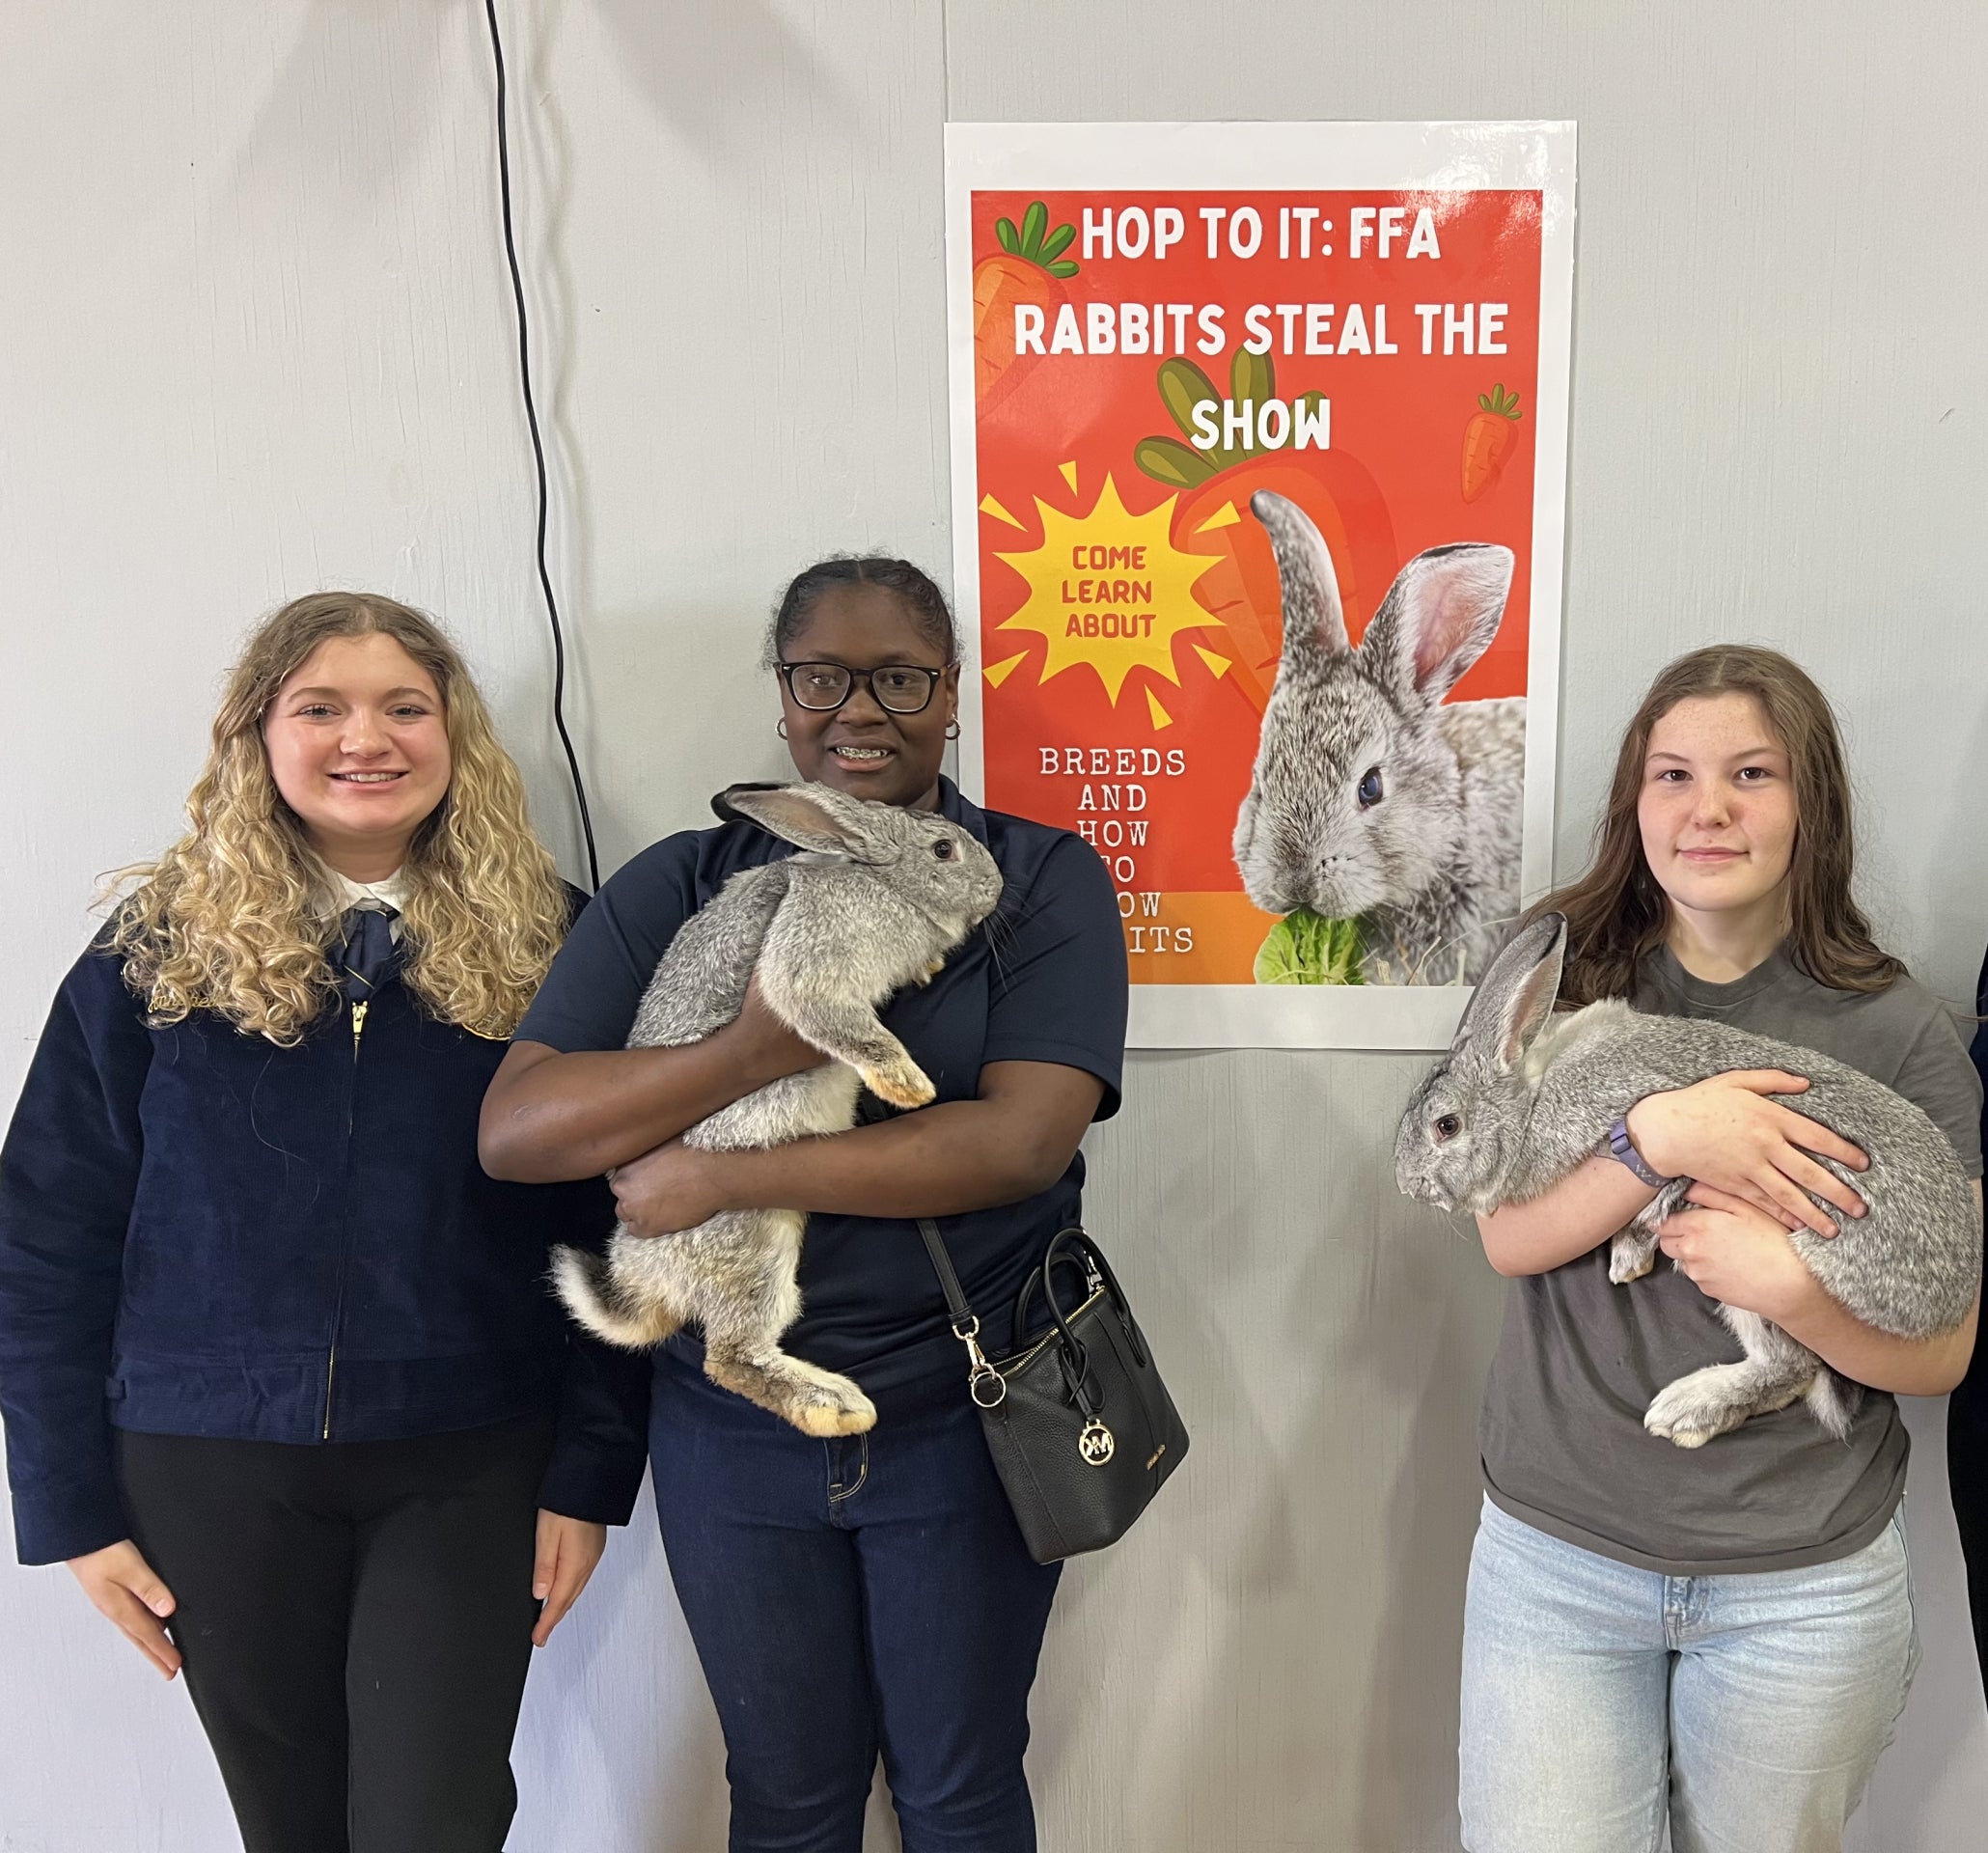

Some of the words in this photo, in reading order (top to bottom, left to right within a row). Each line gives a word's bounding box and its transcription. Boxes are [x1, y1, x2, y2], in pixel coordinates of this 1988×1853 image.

[1082, 206, 1185, 260] HOP
[1199, 206, 1263, 260] TO
[1279, 207, 1333, 260] IT:
[1349, 207, 1441, 260] FFA
[1014, 302, 1227, 356] RABBITS
[1242, 302, 1398, 356] STEAL
[1414, 302, 1508, 356] THE
[1190, 399, 1331, 451] SHOW
[1072, 545, 1147, 570] COME
[1062, 579, 1152, 604] LEARN
[1064, 613, 1157, 639] ABOUT
[1038, 747, 1186, 776] BREEDS
[1077, 784, 1146, 812] AND
[1076, 819, 1149, 847] HOW
[1117, 891, 1161, 918] OW
